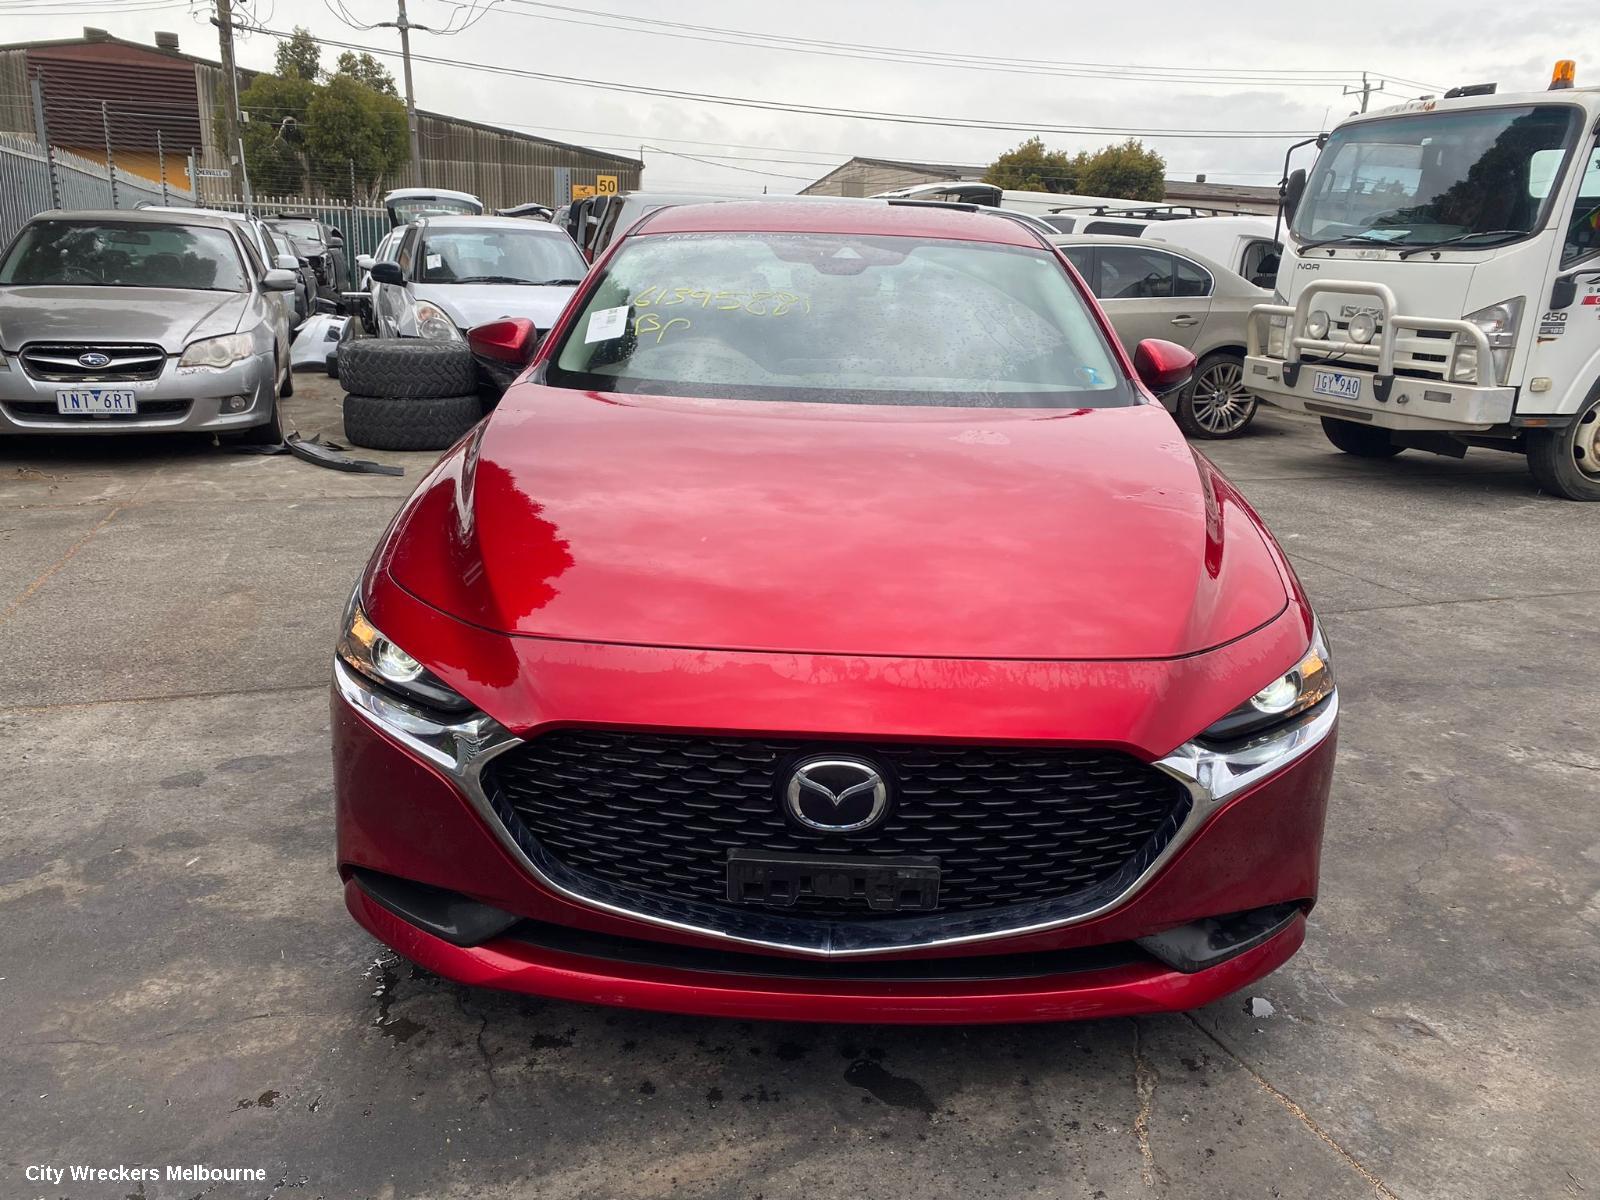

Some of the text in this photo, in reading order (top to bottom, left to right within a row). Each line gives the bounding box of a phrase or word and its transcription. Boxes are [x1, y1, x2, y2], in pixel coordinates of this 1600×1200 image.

[599, 180, 616, 193] 50
[1542, 312, 1568, 321] 450
[62, 394, 132, 408] 1NT 6RT
